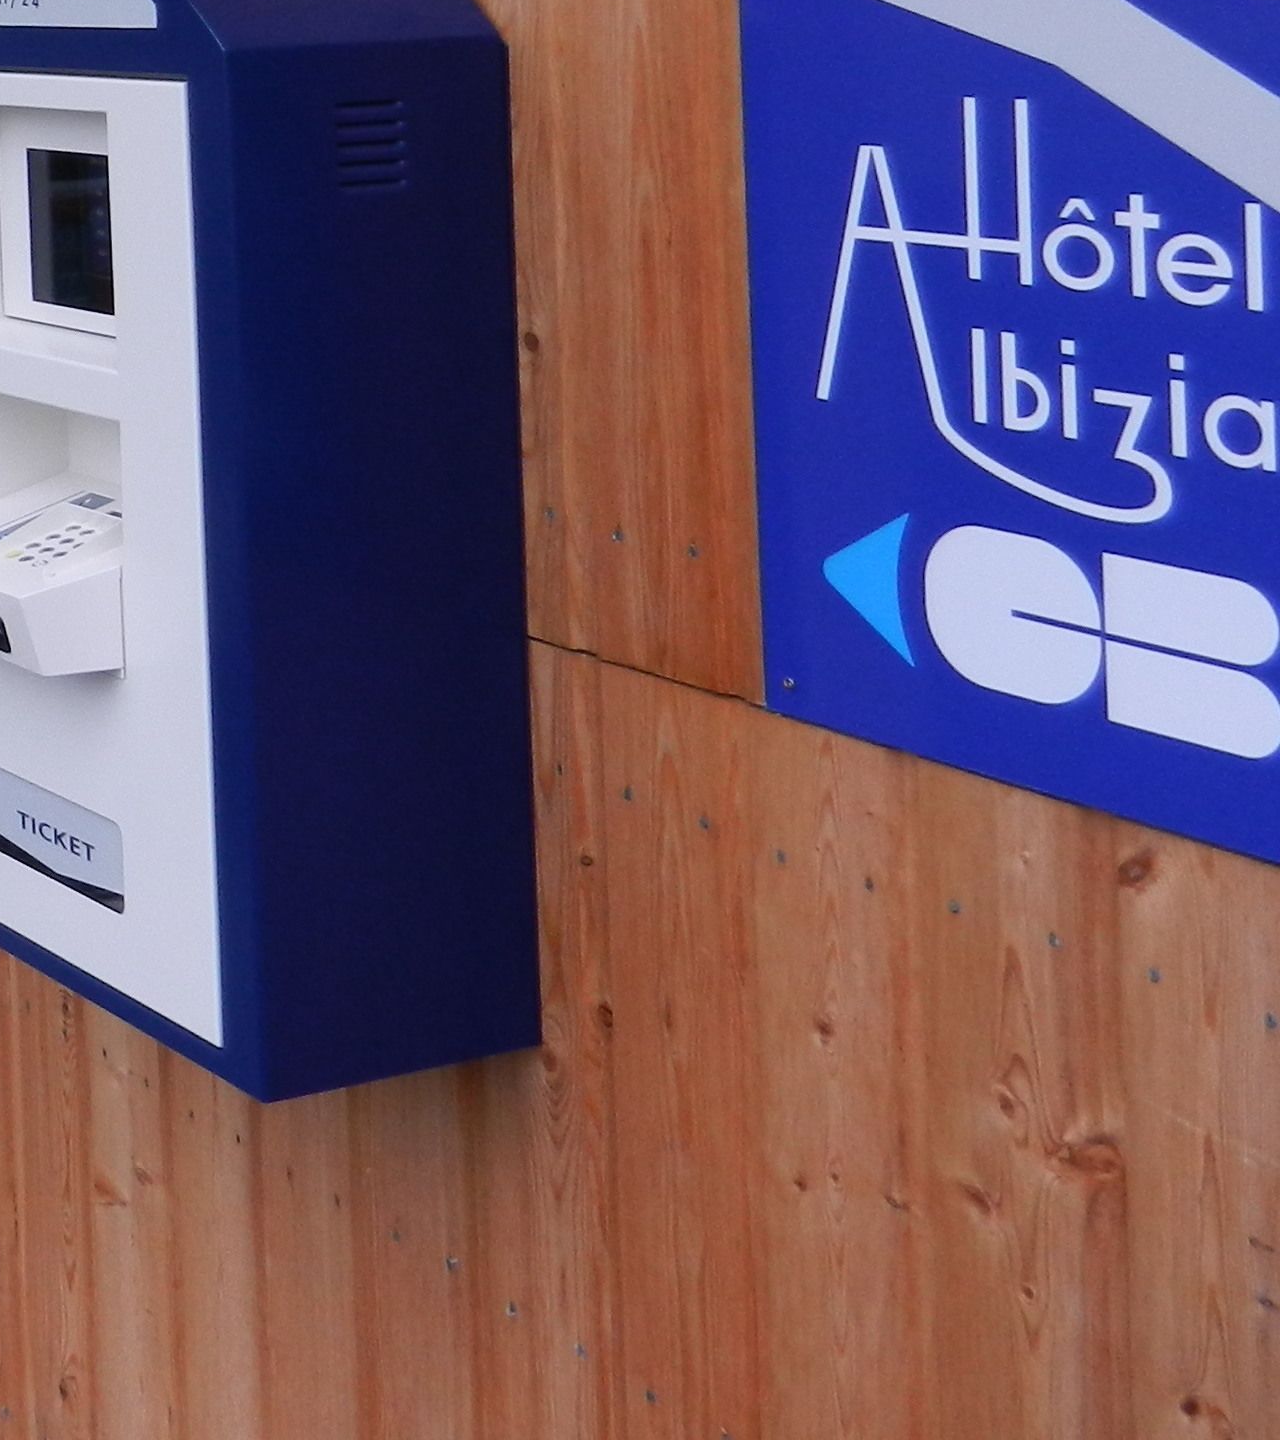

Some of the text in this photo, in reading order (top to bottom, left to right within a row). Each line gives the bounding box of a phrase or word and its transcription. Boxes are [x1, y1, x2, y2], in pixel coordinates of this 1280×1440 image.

[960, 96, 1264, 312] Hôtel
[815, 144, 1277, 524] Albizia
[17, 810, 96, 862] TICKET
